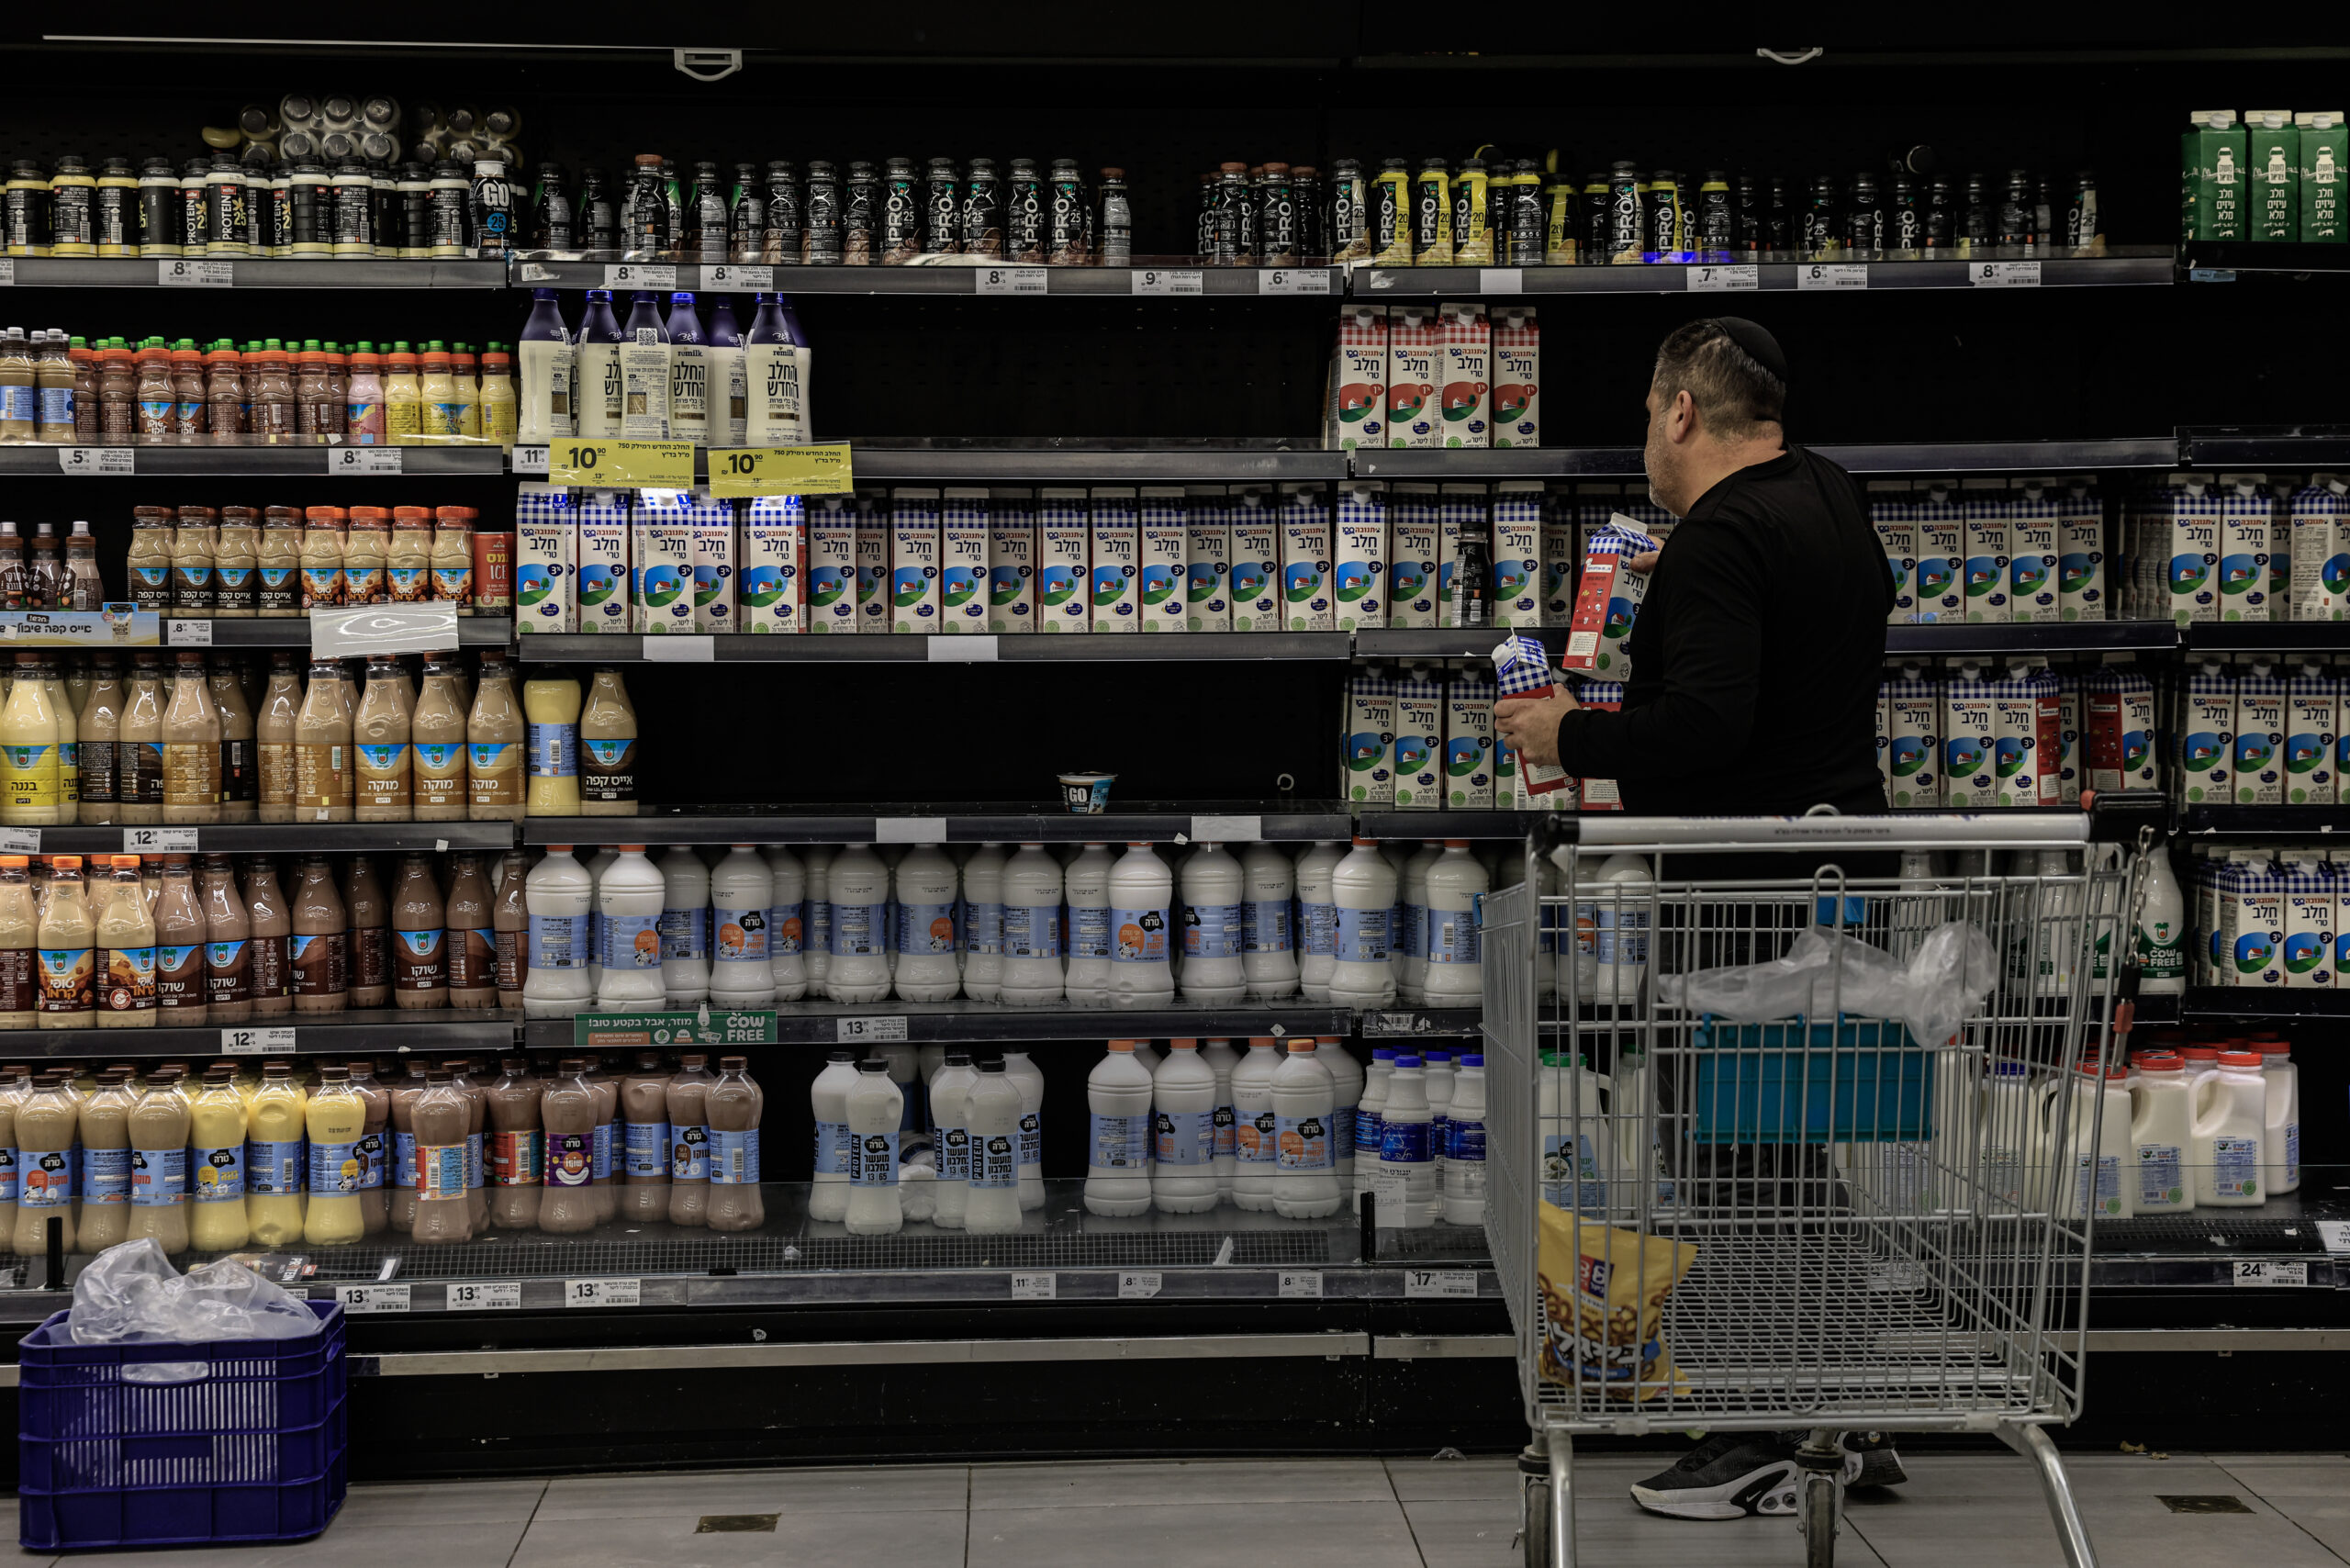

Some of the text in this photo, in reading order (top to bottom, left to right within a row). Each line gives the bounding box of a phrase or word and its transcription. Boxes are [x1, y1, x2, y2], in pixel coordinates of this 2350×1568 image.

[482, 183, 509, 207] GO
[2219, 189, 2233, 198] חלב
[2317, 188, 2333, 198] חלב
[2216, 200, 2235, 209] עיזים
[2267, 200, 2287, 209] עיזים
[2315, 199, 2335, 209] עיזים
[222, 195, 232, 241] PROTEIN
[233, 210, 247, 228] 25
[888, 196, 902, 242] PRO
[903, 211, 914, 222] 25
[1024, 198, 1038, 243] PRO
[1055, 198, 1069, 242] PRO
[1336, 199, 1350, 242] PRO
[1398, 213, 1407, 223] 20
[1421, 199, 1437, 243] PRO
[1440, 213, 1449, 222] 20
[1472, 212, 1483, 222] 20
[2218, 210, 2233, 220] מלא
[2269, 210, 2285, 220] מלא
[2317, 210, 2334, 220] מלא
[185, 200, 196, 245] PROTEIN
[491, 216, 504, 229] 25
[1279, 201, 1292, 246] PRO
[1551, 224, 1561, 234] 20
[1619, 201, 1634, 244] PRO
[1658, 207, 1673, 251] PRO
[1814, 225, 1826, 235] 25
[1902, 209, 1915, 250] PRO
[173, 262, 185, 274] 8
[619, 267, 628, 279] 8
[1702, 268, 1711, 281] 7
[1811, 266, 1820, 279] 6
[1983, 264, 1993, 277] 8
[989, 271, 1000, 284] 8
[1146, 272, 1155, 285] 9
[1272, 272, 1282, 285] 6
[674, 361, 705, 380] החלב
[1403, 357, 1428, 371] חלב
[1506, 358, 1531, 372] חלב
[674, 381, 705, 397] החדש
[73, 450, 83, 463] 5
[344, 451, 354, 464] 8
[525, 450, 538, 463] 11
[569, 447, 597, 469] 10
[728, 454, 755, 474] 10
[1351, 534, 1377, 548] חלב
[1977, 531, 2003, 543] חלב
[763, 538, 789, 551] חלב
[906, 541, 931, 554] חלב
[1154, 539, 1179, 552] חלב
[1310, 548, 1323, 556] טרי
[218, 592, 234, 600] קפה
[260, 592, 274, 600] קפה
[11, 622, 92, 634] אייס קפה שיבול
[1364, 707, 1389, 720] חלב
[1461, 711, 1486, 723] חלב
[2202, 706, 2227, 719] חלב
[11, 780, 38, 791] בננה
[367, 779, 398, 791] מוקה
[473, 778, 498, 790] מוקה
[587, 774, 633, 789] אייס קפה
[1069, 788, 1088, 802] GO
[135, 831, 151, 844] 12
[2302, 906, 2327, 920] חלב
[745, 918, 760, 926] טרה
[2150, 949, 2177, 958] COW
[2151, 958, 2176, 967] FREE
[411, 965, 438, 976] שוקו
[50, 977, 74, 989] טופי
[158, 981, 185, 993] שוקו
[588, 1018, 691, 1028] מוזר, אבל בקטע טוב!
[727, 1014, 766, 1028] COW
[846, 1021, 863, 1035] 13
[233, 1033, 250, 1046] 12
[728, 1029, 765, 1042] FREE
[566, 1139, 580, 1148] טרה
[950, 1133, 964, 1142] טרה
[864, 1154, 890, 1163] מועשר
[974, 1139, 982, 1180] PROTEIN
[987, 1155, 1012, 1164] מועשר
[865, 1162, 890, 1173] בחלבון
[988, 1164, 1012, 1175] בחלבון
[50, 1174, 69, 1186] מוקה
[220, 1170, 239, 1182] בננה
[2242, 1263, 2261, 1277] 24
[1016, 1279, 1024, 1287] 11
[1415, 1272, 1430, 1285] 17
[457, 1287, 474, 1301] 13
[576, 1283, 593, 1297] 13
[346, 1290, 363, 1304] 13
